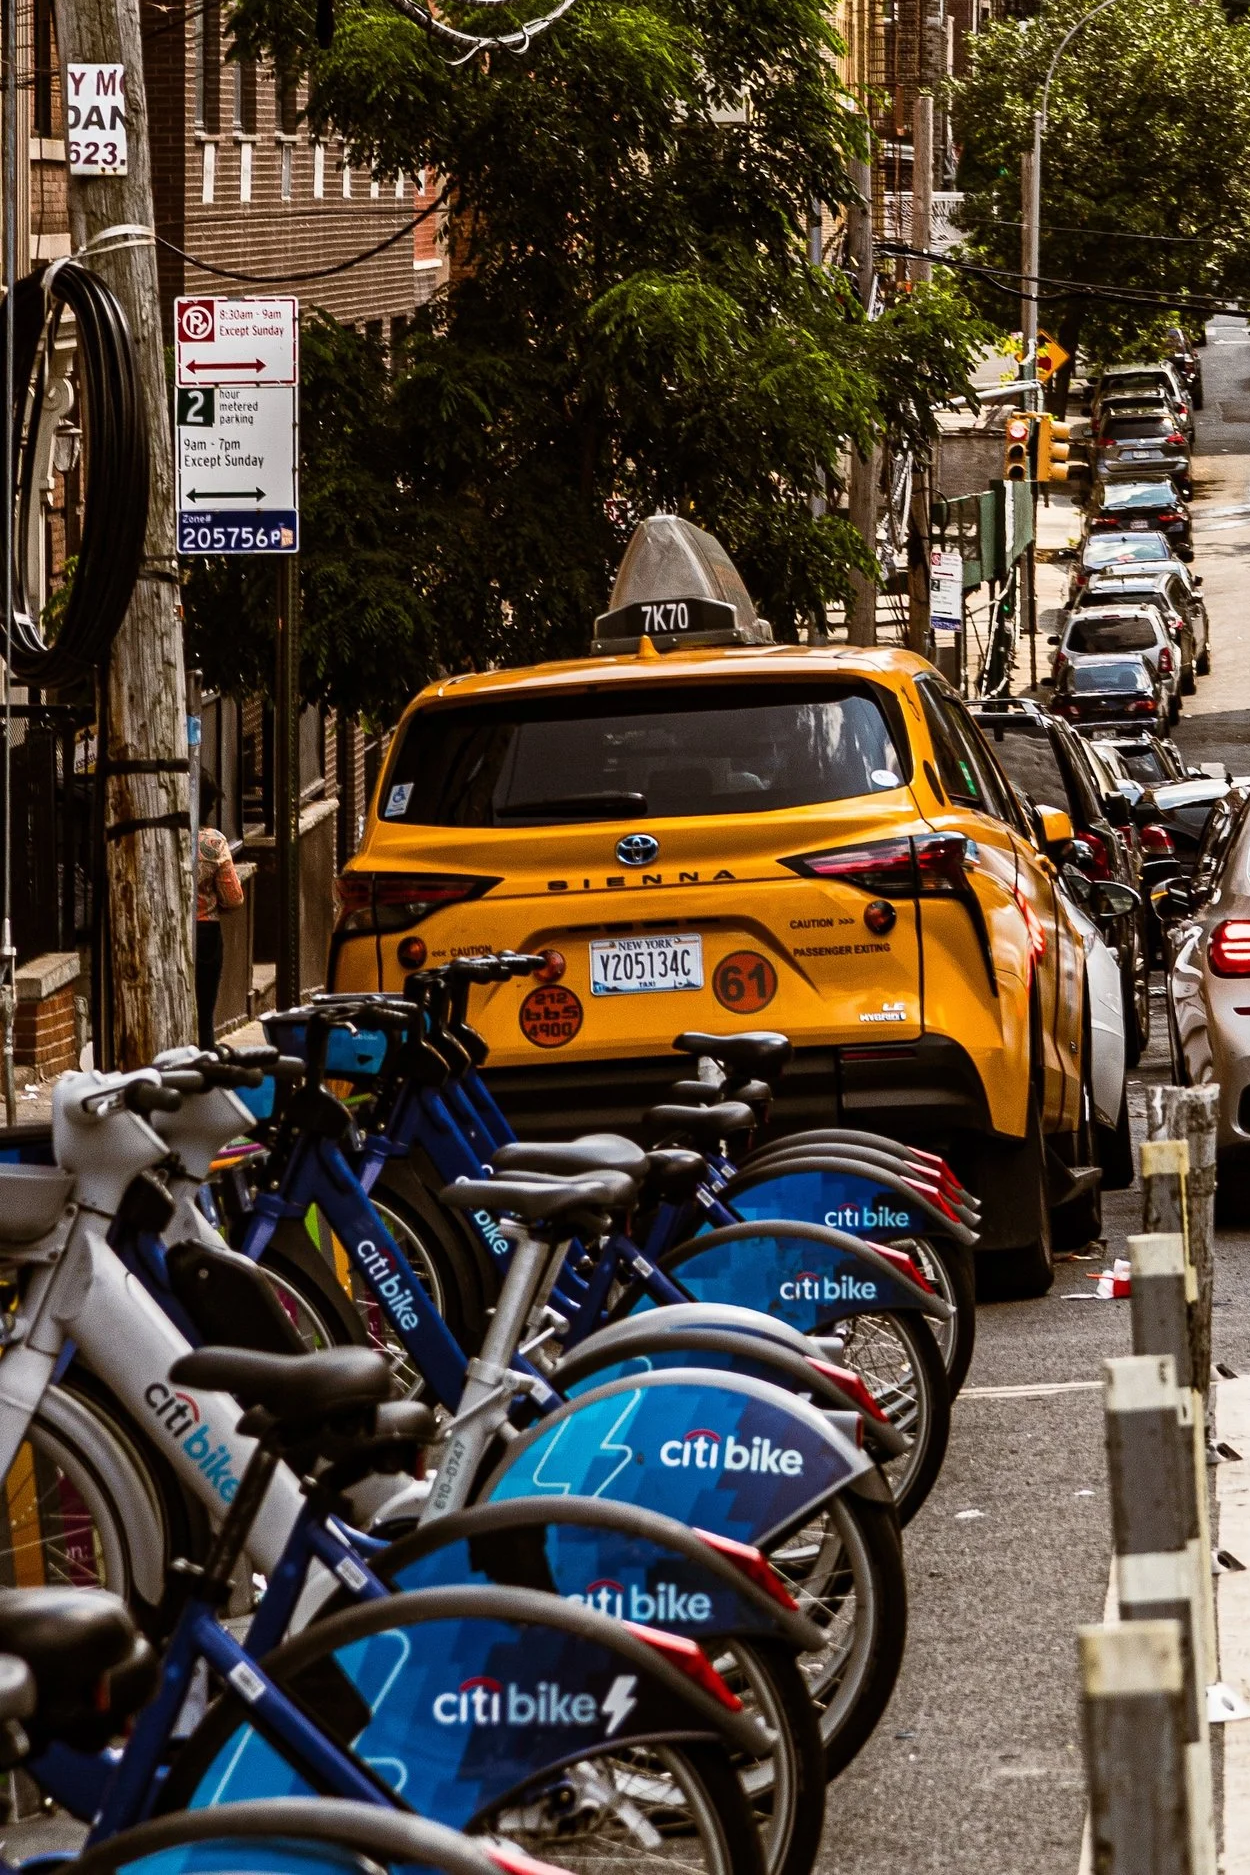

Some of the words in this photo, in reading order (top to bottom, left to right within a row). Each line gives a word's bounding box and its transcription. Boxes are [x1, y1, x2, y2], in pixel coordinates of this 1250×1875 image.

[68, 72, 87, 96] Y
[96, 70, 125, 96] M
[68, 105, 126, 131] DAN
[69, 141, 126, 166] 623.
[219, 309, 254, 320] 8:30am
[262, 309, 282, 320] 9am
[219, 325, 250, 337] Except
[252, 325, 285, 338] Sunday
[219, 389, 240, 399] hour
[186, 390, 204, 423] 2
[219, 401, 259, 412] metered
[219, 413, 254, 425] parking
[184, 438, 207, 451] 9am
[219, 438, 241, 451] 7pm
[184, 454, 221, 469] Except
[224, 454, 265, 469] Sunday
[182, 527, 269, 549] 205756
[641, 602, 689, 632] 7K70
[548, 869, 736, 891] SIENNA
[790, 918, 834, 929] CAUTION
[450, 944, 493, 958] CAUTION
[618, 940, 643, 951] NEW
[645, 938, 674, 950] YORK
[793, 945, 852, 957] PASSENGER
[854, 943, 891, 955] EXITING
[600, 949, 692, 982] Y205134C
[719, 962, 767, 1002] 61
[534, 992, 569, 1005] 212
[527, 1022, 573, 1038] 4900
[824, 1203, 860, 1227] citi
[863, 1205, 910, 1228] bike
[357, 1240, 396, 1282] citi
[379, 1273, 419, 1331] bike
[780, 1271, 820, 1301] citi
[823, 1275, 877, 1300] bike
[144, 1382, 200, 1438] citi
[660, 1429, 721, 1470] citi
[724, 1435, 804, 1476] bike
[630, 1582, 713, 1621] bike
[433, 1676, 502, 1725] citi
[508, 1680, 598, 1724] bike
